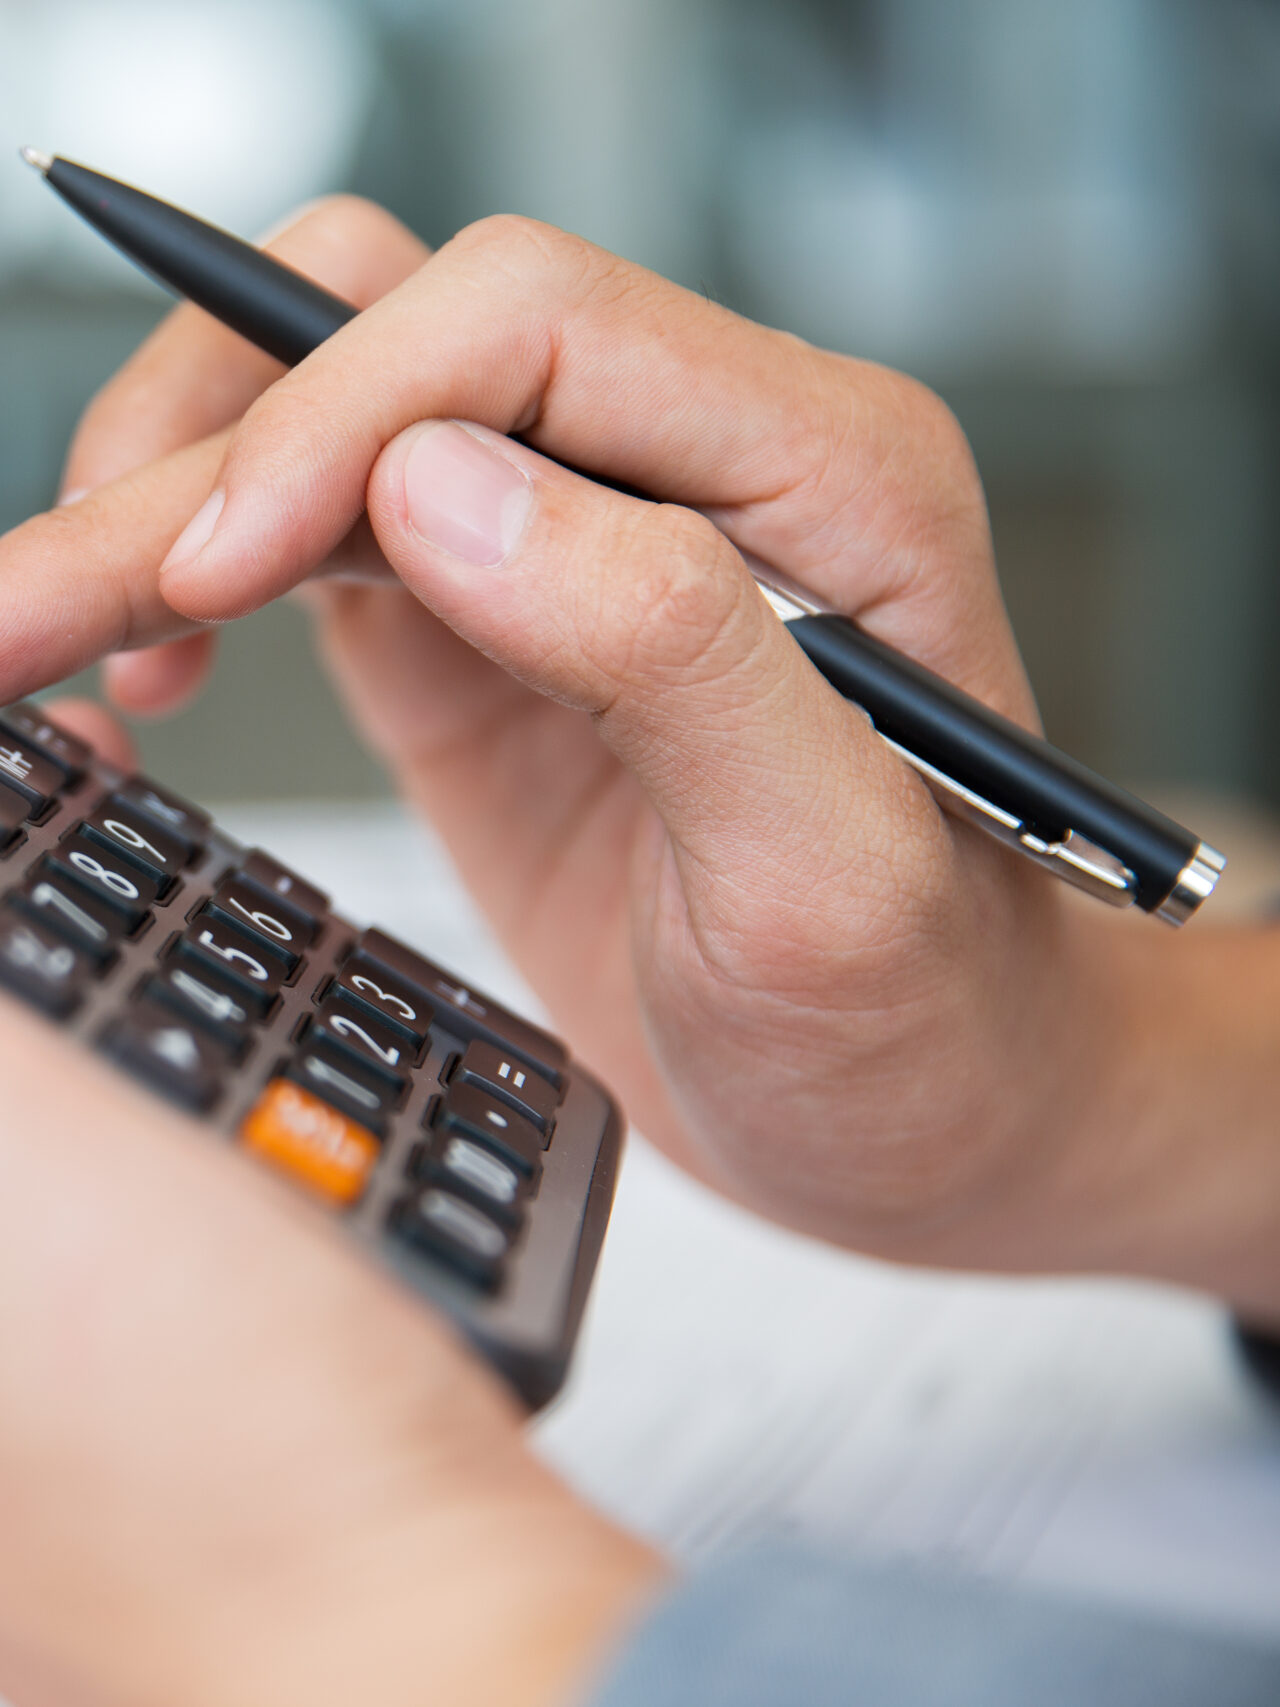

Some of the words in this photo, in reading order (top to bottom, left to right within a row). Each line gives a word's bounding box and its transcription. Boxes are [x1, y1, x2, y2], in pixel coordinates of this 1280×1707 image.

[103, 819, 167, 863] 9
[69, 851, 140, 899] 8
[31, 881, 109, 943] 7
[228, 897, 293, 942] 6
[198, 931, 269, 981] 5
[170, 968, 247, 1023] 4
[351, 974, 417, 1020] 3
[329, 1014, 401, 1067] 2
[304, 1055, 382, 1110] 1
